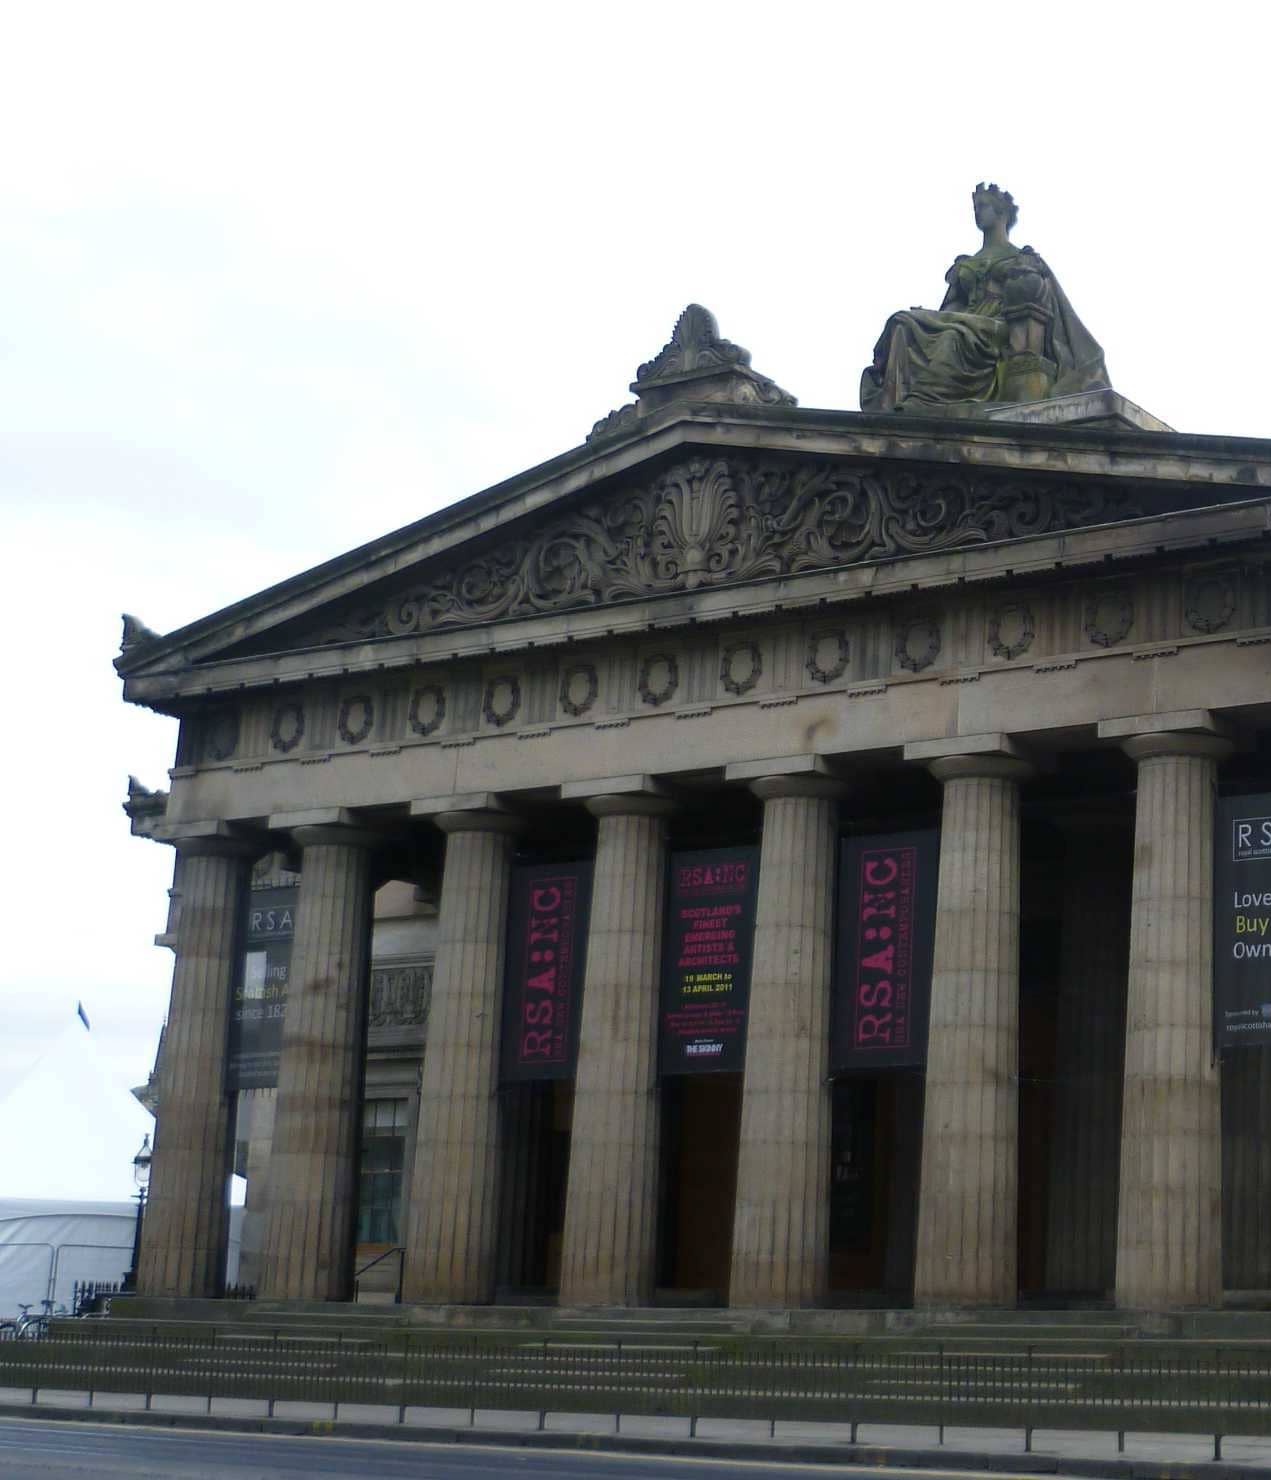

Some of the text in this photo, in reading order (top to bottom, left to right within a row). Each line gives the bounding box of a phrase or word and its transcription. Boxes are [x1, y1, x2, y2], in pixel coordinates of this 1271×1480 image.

[252, 911, 293, 931] RSA
[1235, 914, 1269, 937] Buy
[696, 973, 723, 982] MARCH
[692, 984, 714, 993] APRIL
[715, 983, 733, 992] 2011
